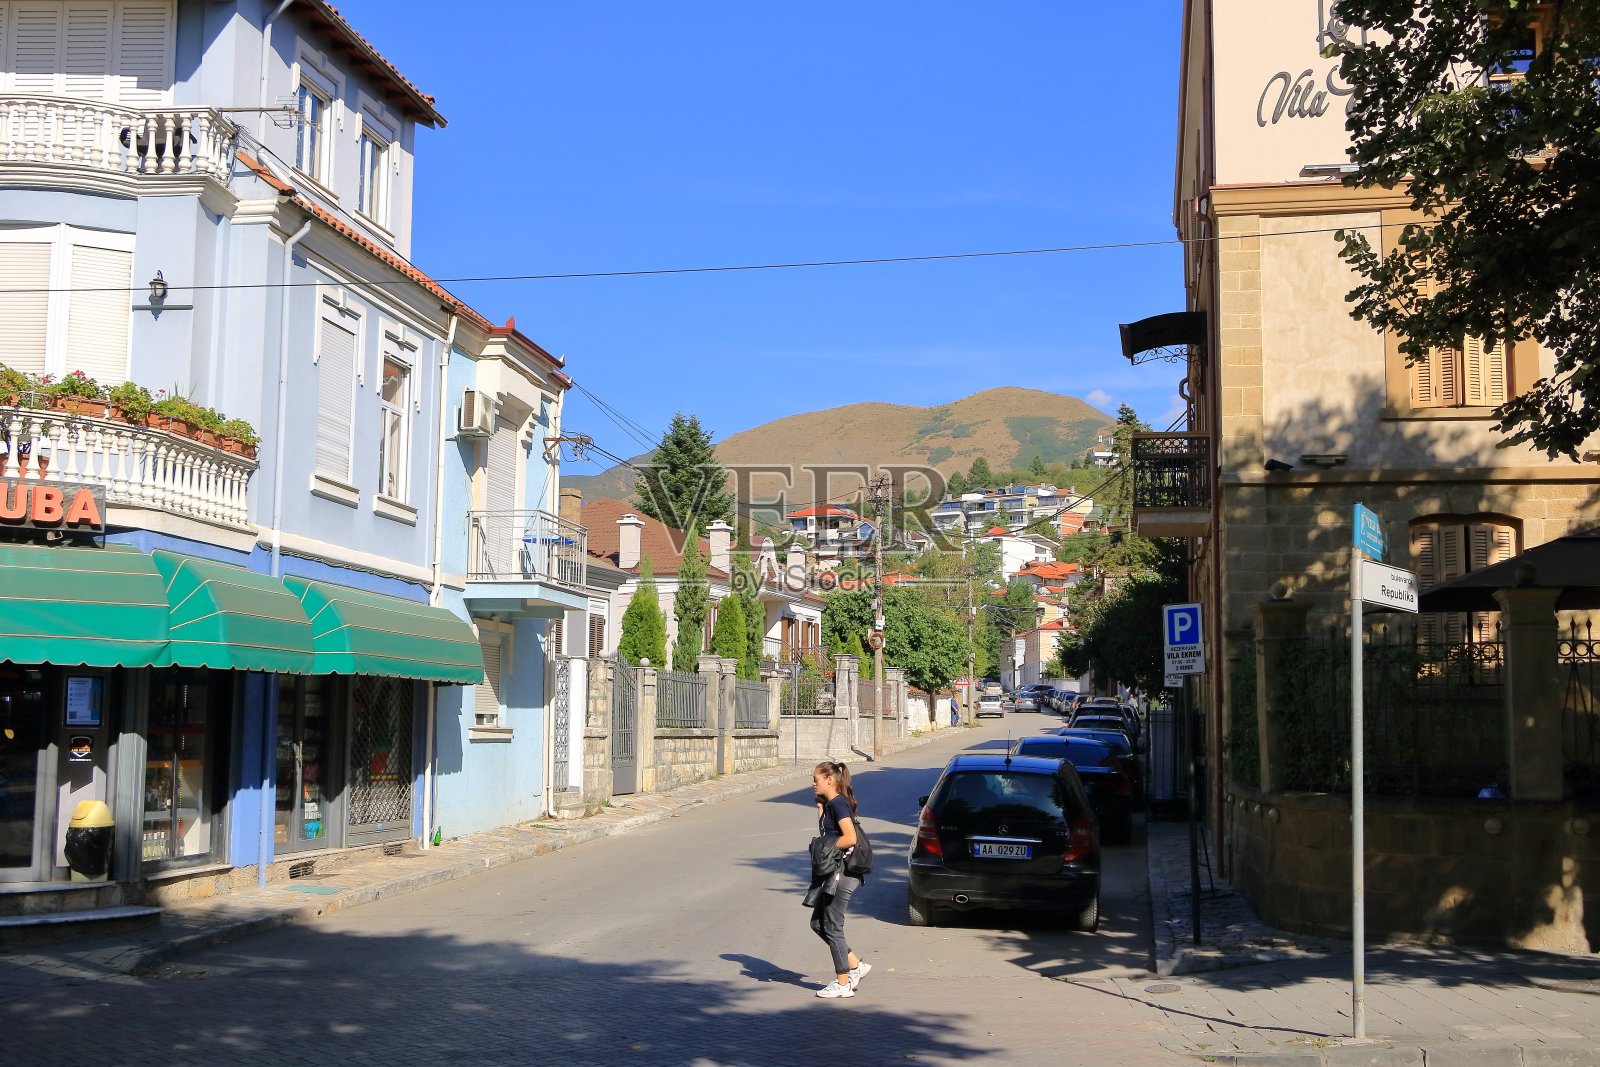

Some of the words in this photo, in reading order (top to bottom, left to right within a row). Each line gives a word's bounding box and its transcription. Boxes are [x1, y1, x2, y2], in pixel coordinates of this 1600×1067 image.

[1257, 68, 1330, 127] Vila
[1381, 585, 1414, 603] Republika
[1173, 612, 1192, 642] P
[1181, 651, 1202, 659] EKREM
[982, 845, 993, 855] AA
[997, 845, 1013, 856] 029
[1015, 846, 1026, 856] ZU
